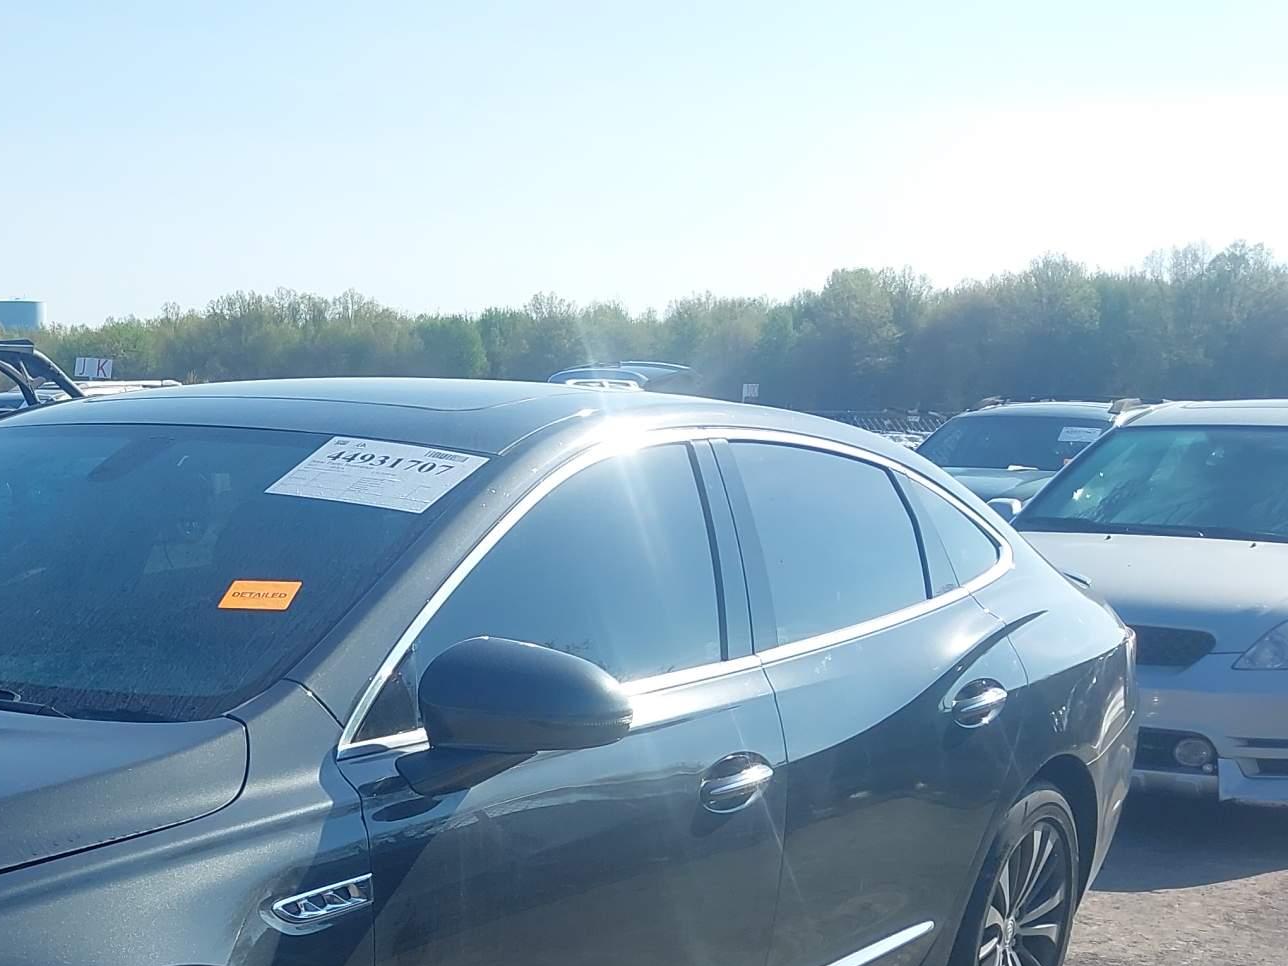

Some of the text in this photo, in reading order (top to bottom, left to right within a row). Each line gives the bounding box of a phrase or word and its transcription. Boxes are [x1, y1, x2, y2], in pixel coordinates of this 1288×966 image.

[78, 358, 109, 378] J K
[326, 449, 455, 477] 44931707
[231, 591, 288, 599] DETAILED
